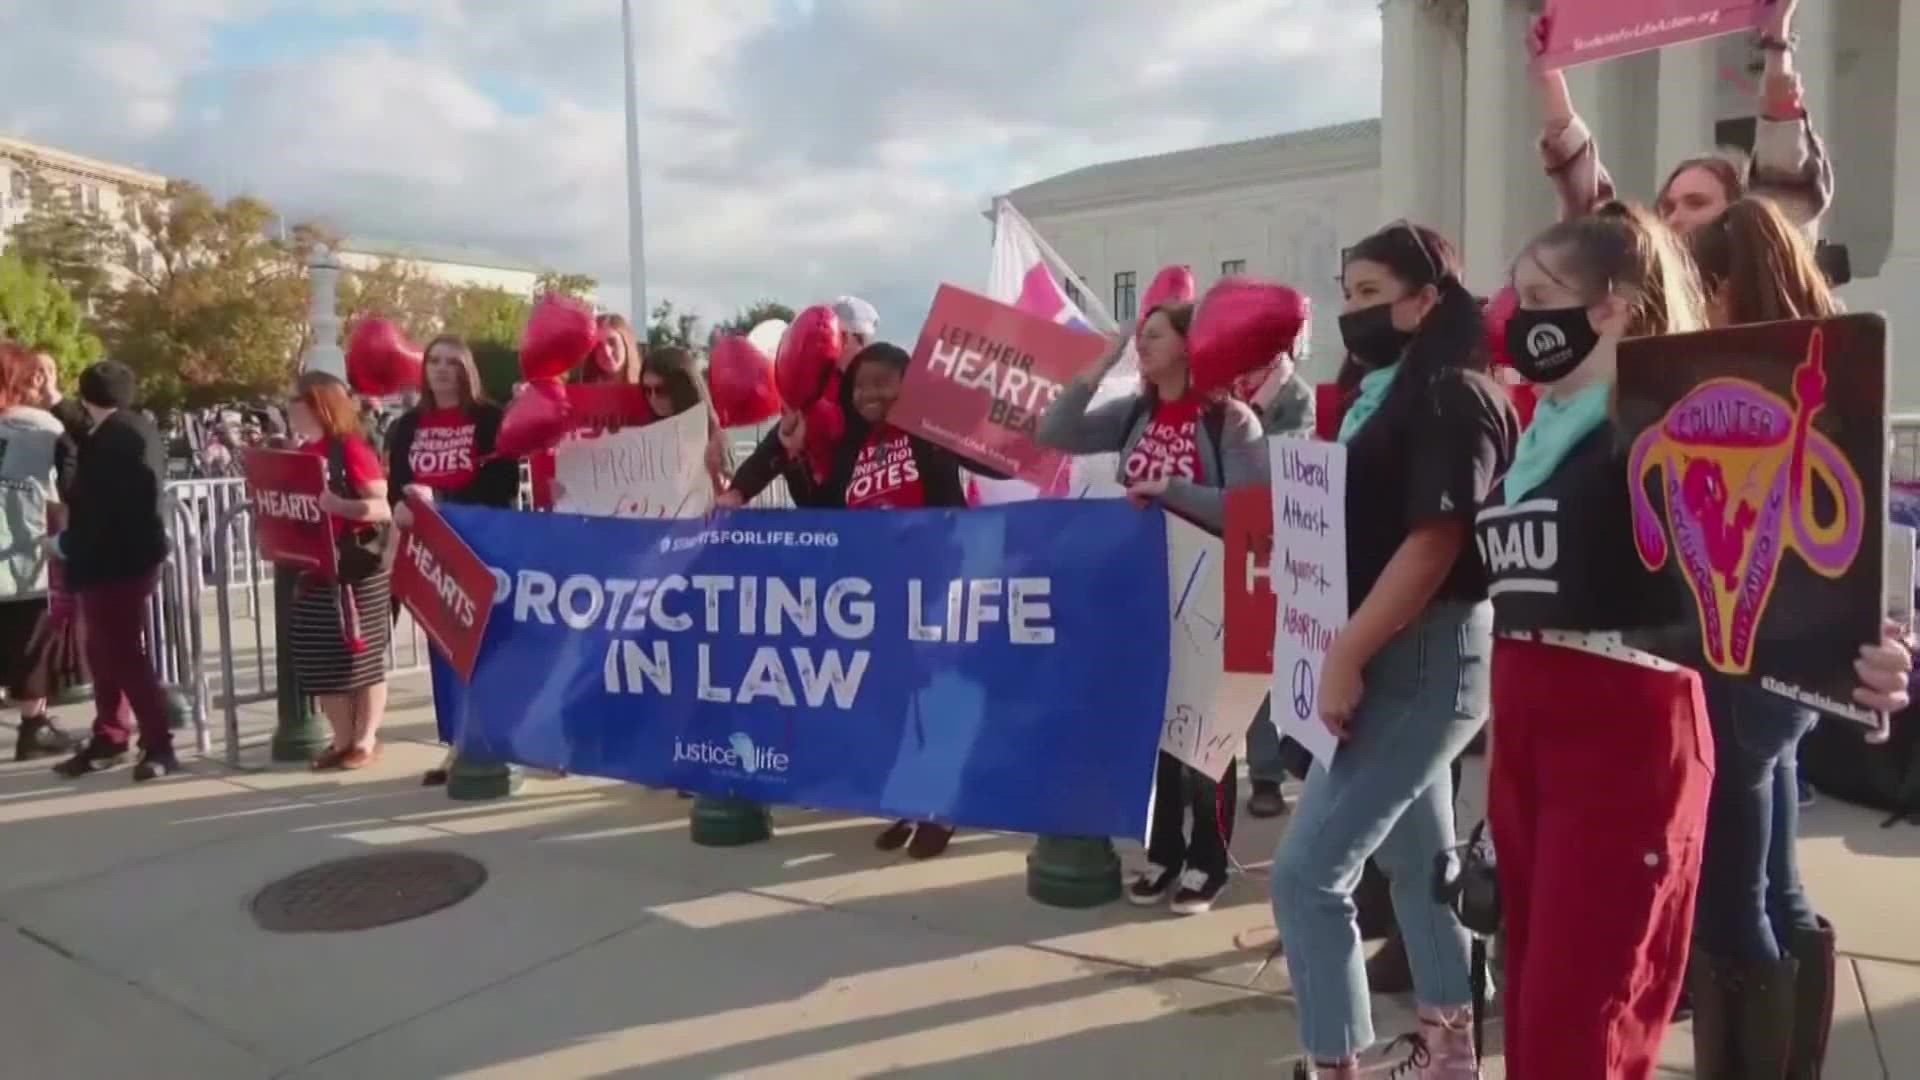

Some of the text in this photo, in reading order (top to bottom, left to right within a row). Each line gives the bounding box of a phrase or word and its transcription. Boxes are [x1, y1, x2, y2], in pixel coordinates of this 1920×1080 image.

[939, 324, 1036, 373] LET THEIR
[987, 398, 1037, 434] BEA
[408, 448, 473, 473] VOTES
[256, 488, 321, 522] HEARTS
[406, 532, 477, 628] HEARTS
[908, 577, 1055, 644] LIFE
[604, 640, 870, 710] IN LAW
[672, 735, 789, 771] justice life
